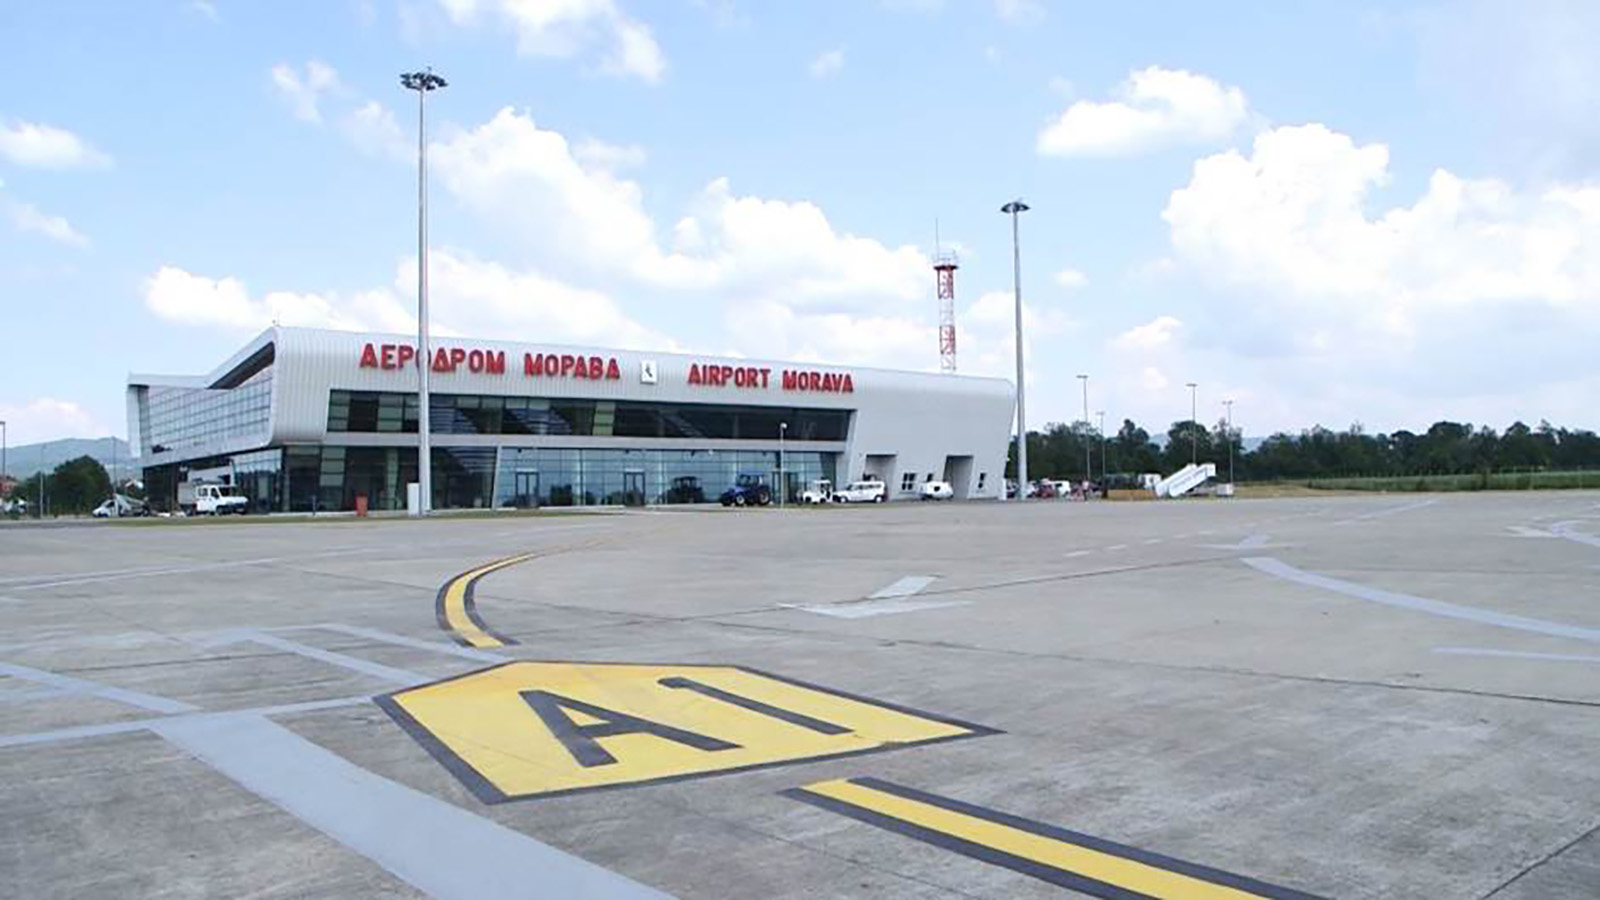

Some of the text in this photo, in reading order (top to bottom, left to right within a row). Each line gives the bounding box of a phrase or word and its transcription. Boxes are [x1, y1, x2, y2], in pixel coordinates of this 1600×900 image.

[524, 352, 620, 380] МОРАВА
[688, 363, 853, 393] AIRPORT MORAVA
[518, 677, 855, 767] A1
